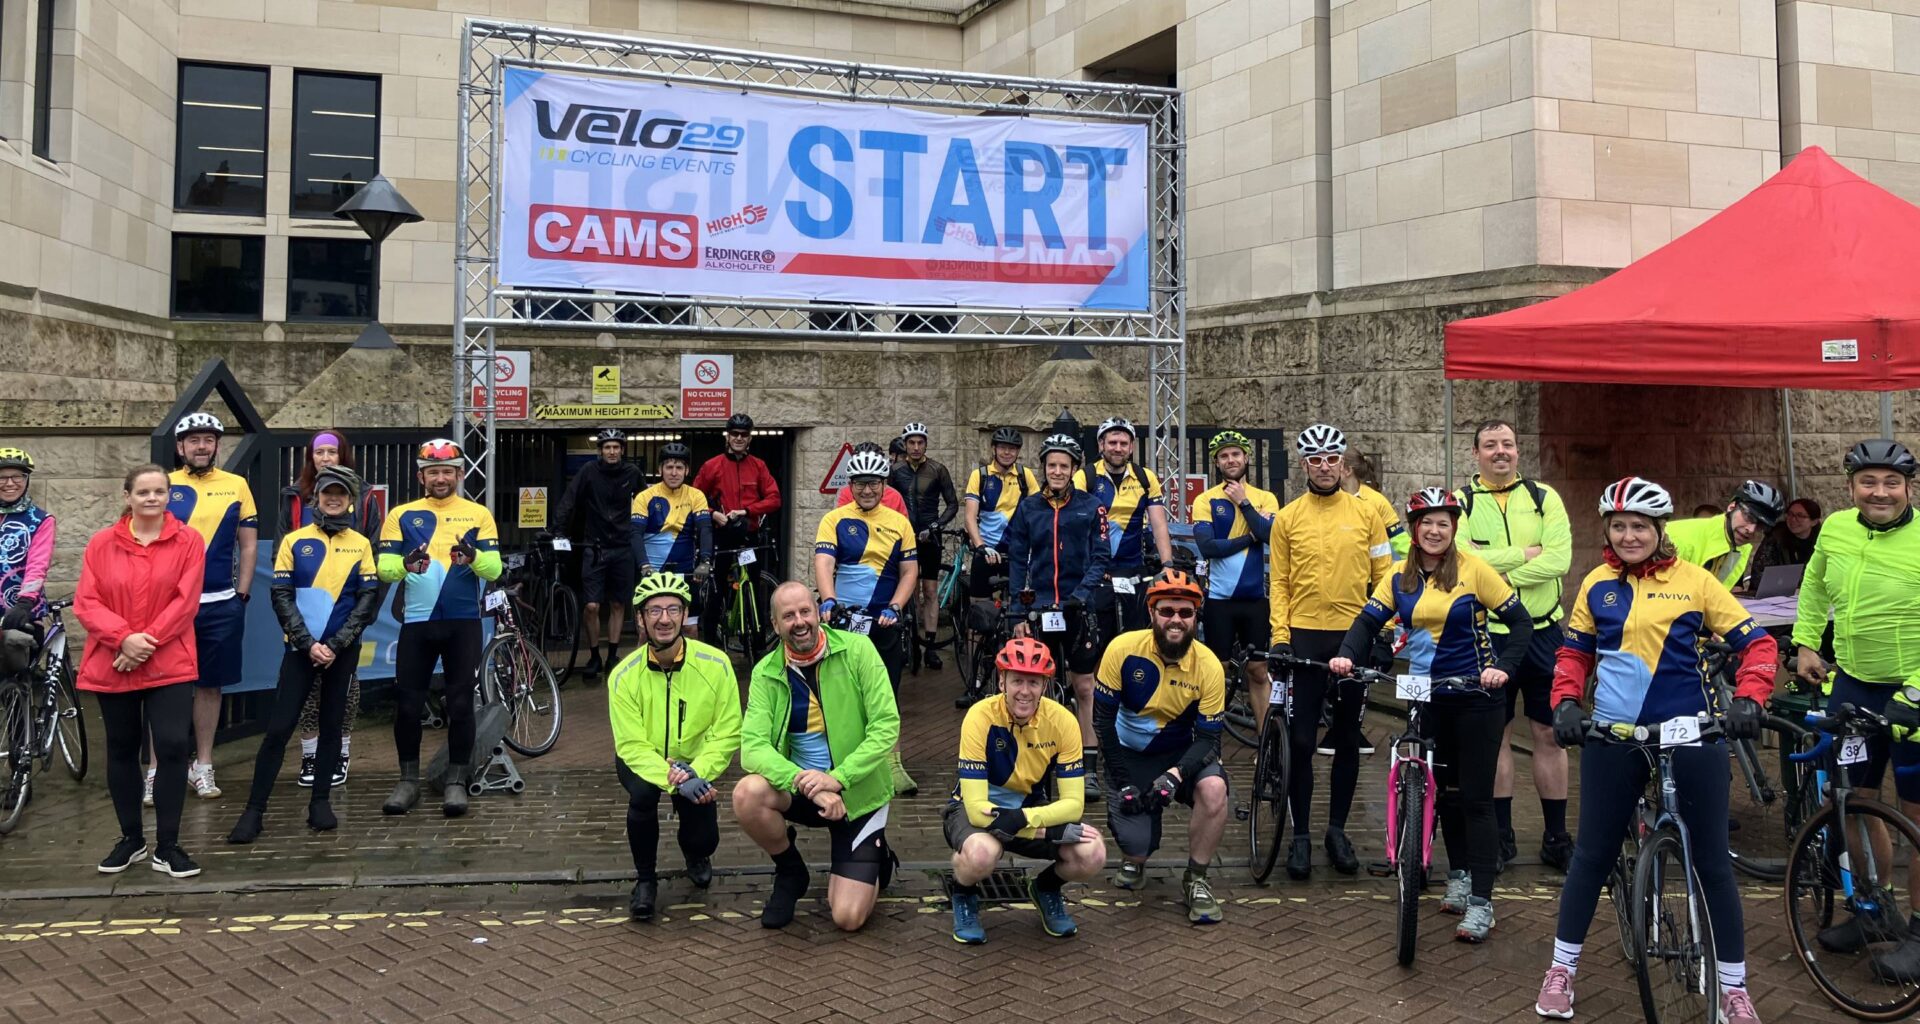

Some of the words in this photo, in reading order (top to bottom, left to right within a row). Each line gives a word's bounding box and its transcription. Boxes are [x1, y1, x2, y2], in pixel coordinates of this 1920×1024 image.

[571, 149, 656, 169] CYCLING
[661, 156, 735, 175] EVENTS
[784, 125, 1128, 251] START
[533, 210, 693, 261] CAMS
[705, 246, 762, 263] ERDINGER
[705, 261, 775, 271] ALKOHOLFREI
[544, 407, 592, 416] MAXIMUM
[595, 407, 631, 416] HEIGHT
[633, 407, 639, 416] 2
[1657, 592, 1691, 602] AVIVA
[1049, 618, 1060, 627] 14
[1177, 681, 1200, 692] AVIVA
[1406, 684, 1421, 695] 80
[1272, 689, 1284, 699] 71
[1669, 727, 1689, 740] 72
[1034, 740, 1057, 750] AVIVA
[1845, 744, 1860, 757] 38
